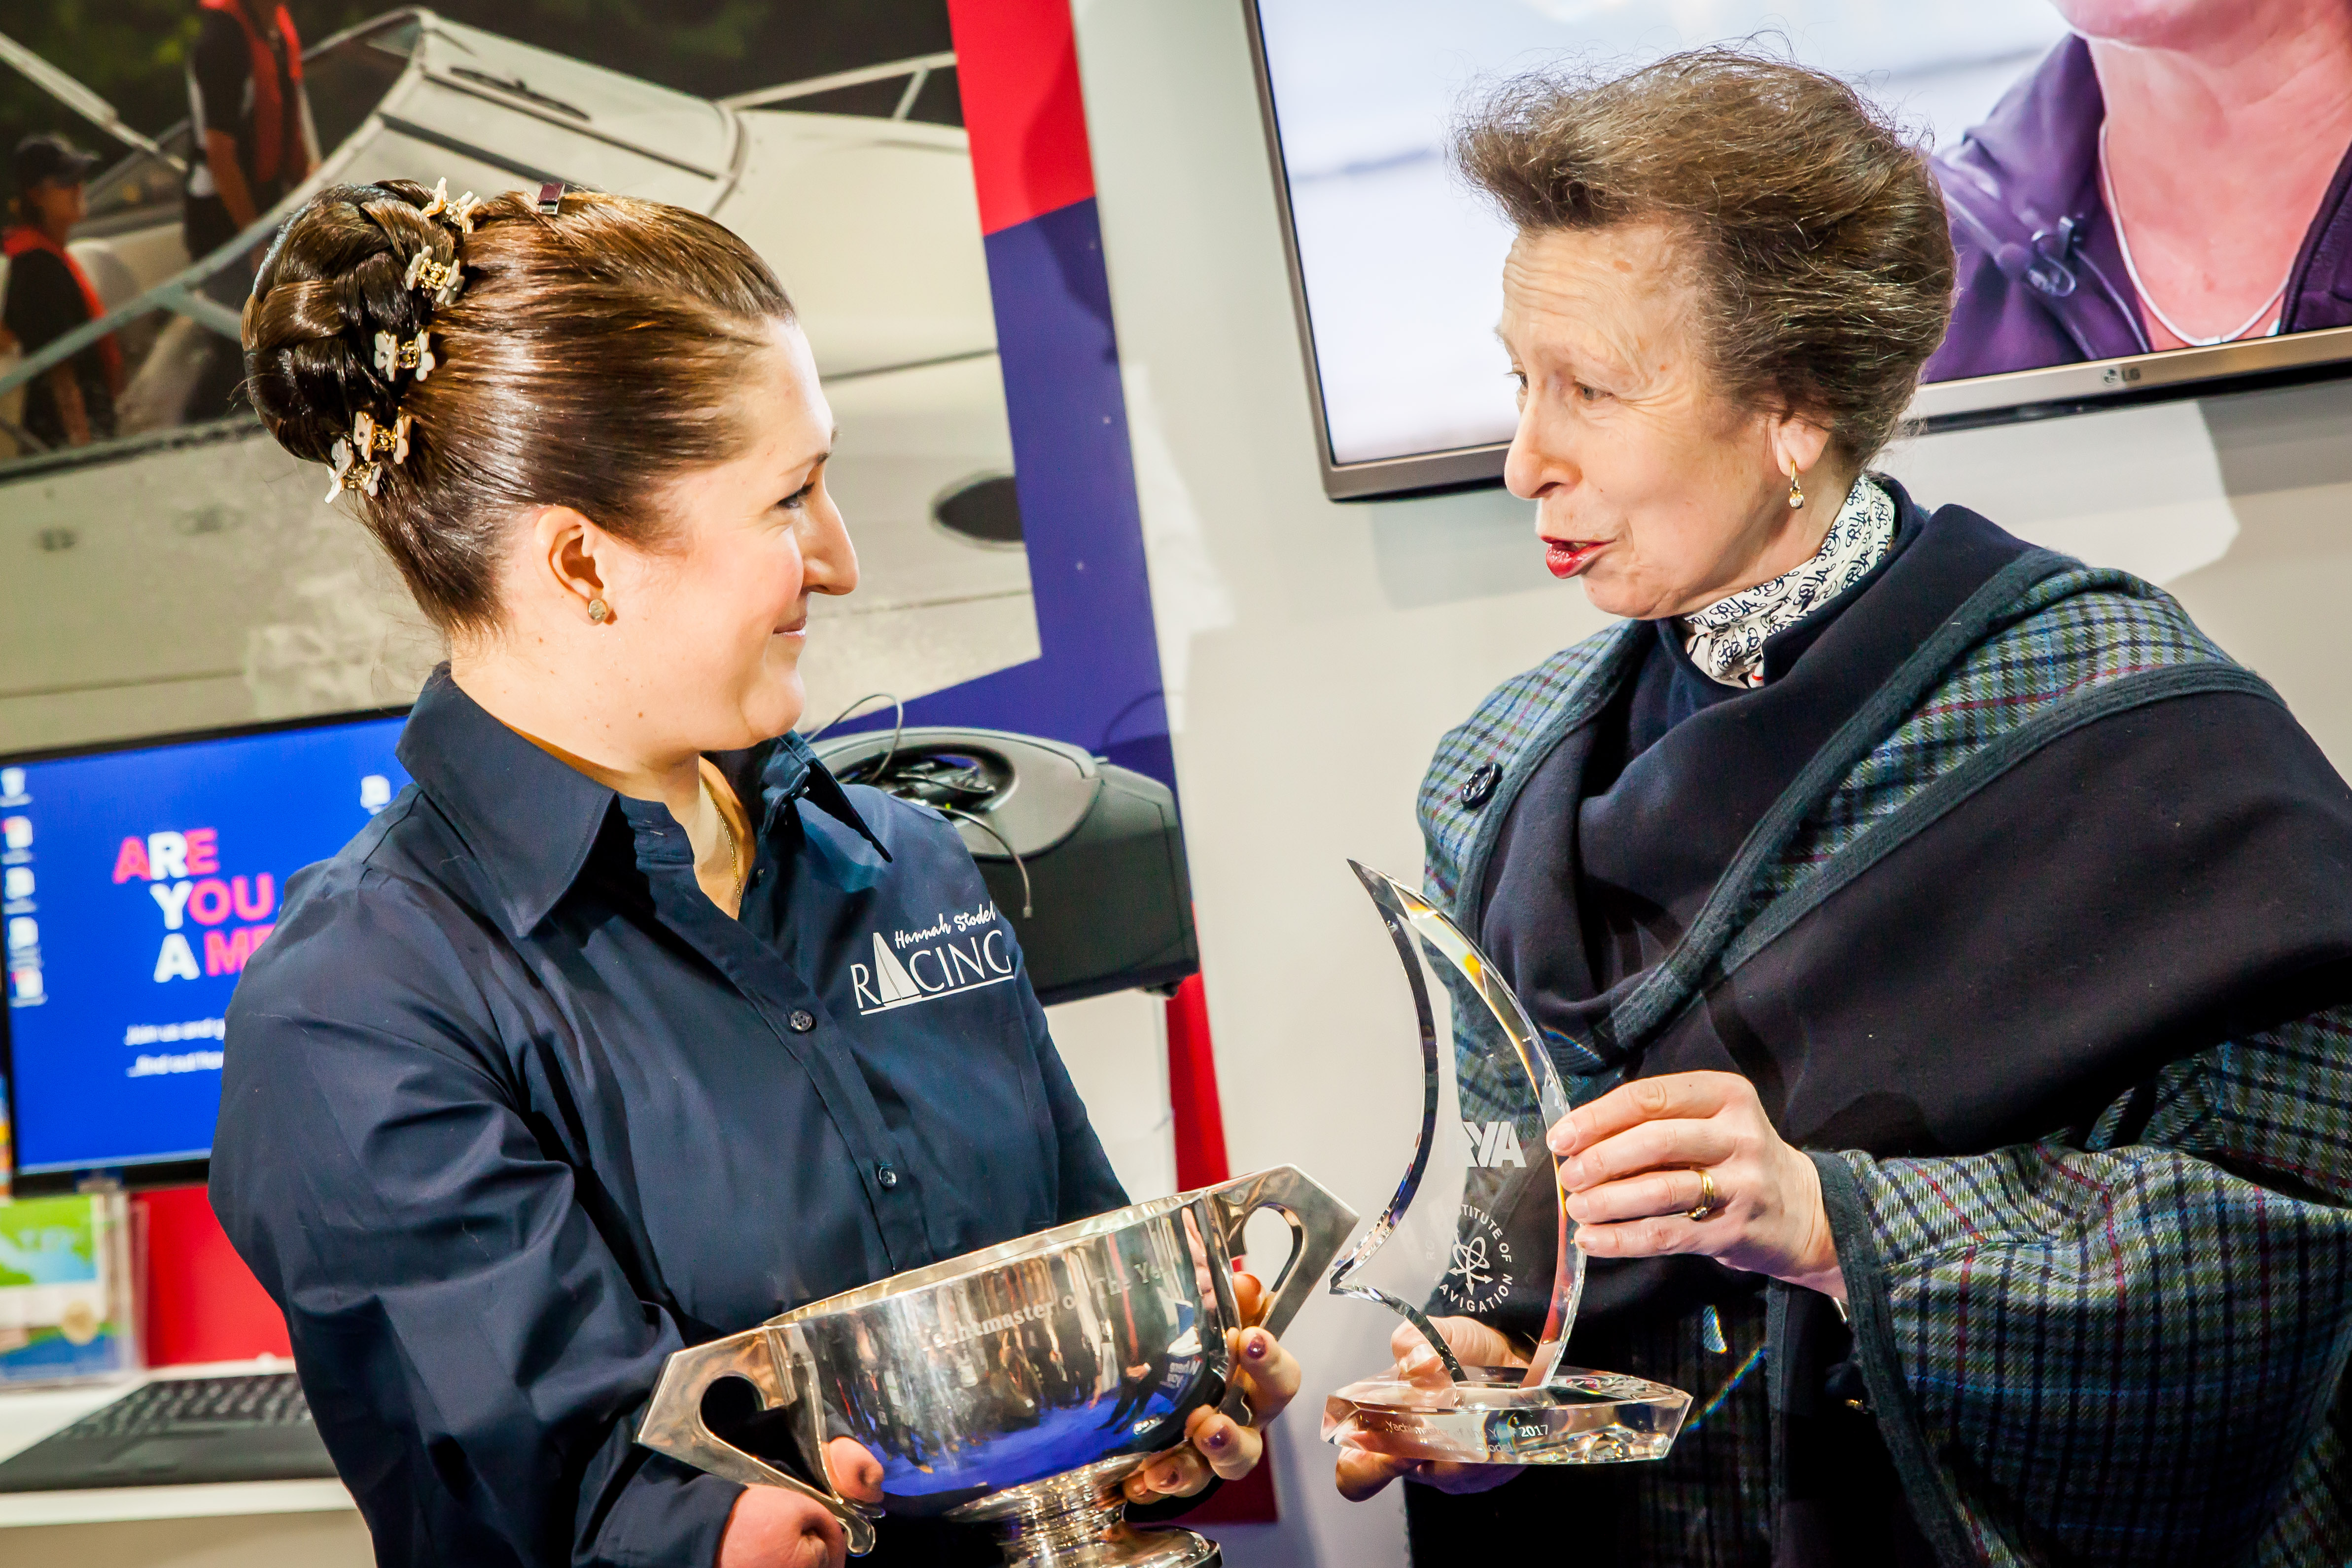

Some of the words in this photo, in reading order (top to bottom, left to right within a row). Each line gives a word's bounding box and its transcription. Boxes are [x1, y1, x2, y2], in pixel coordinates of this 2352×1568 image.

[112, 828, 220, 884] ARE
[149, 872, 275, 931] YOU
[895, 913, 951, 949] Hannah
[953, 901, 996, 932] Stodel
[153, 932, 201, 983] A
[1499, 1243, 1512, 1262] OF
[1519, 1425, 1549, 1438] 2017
